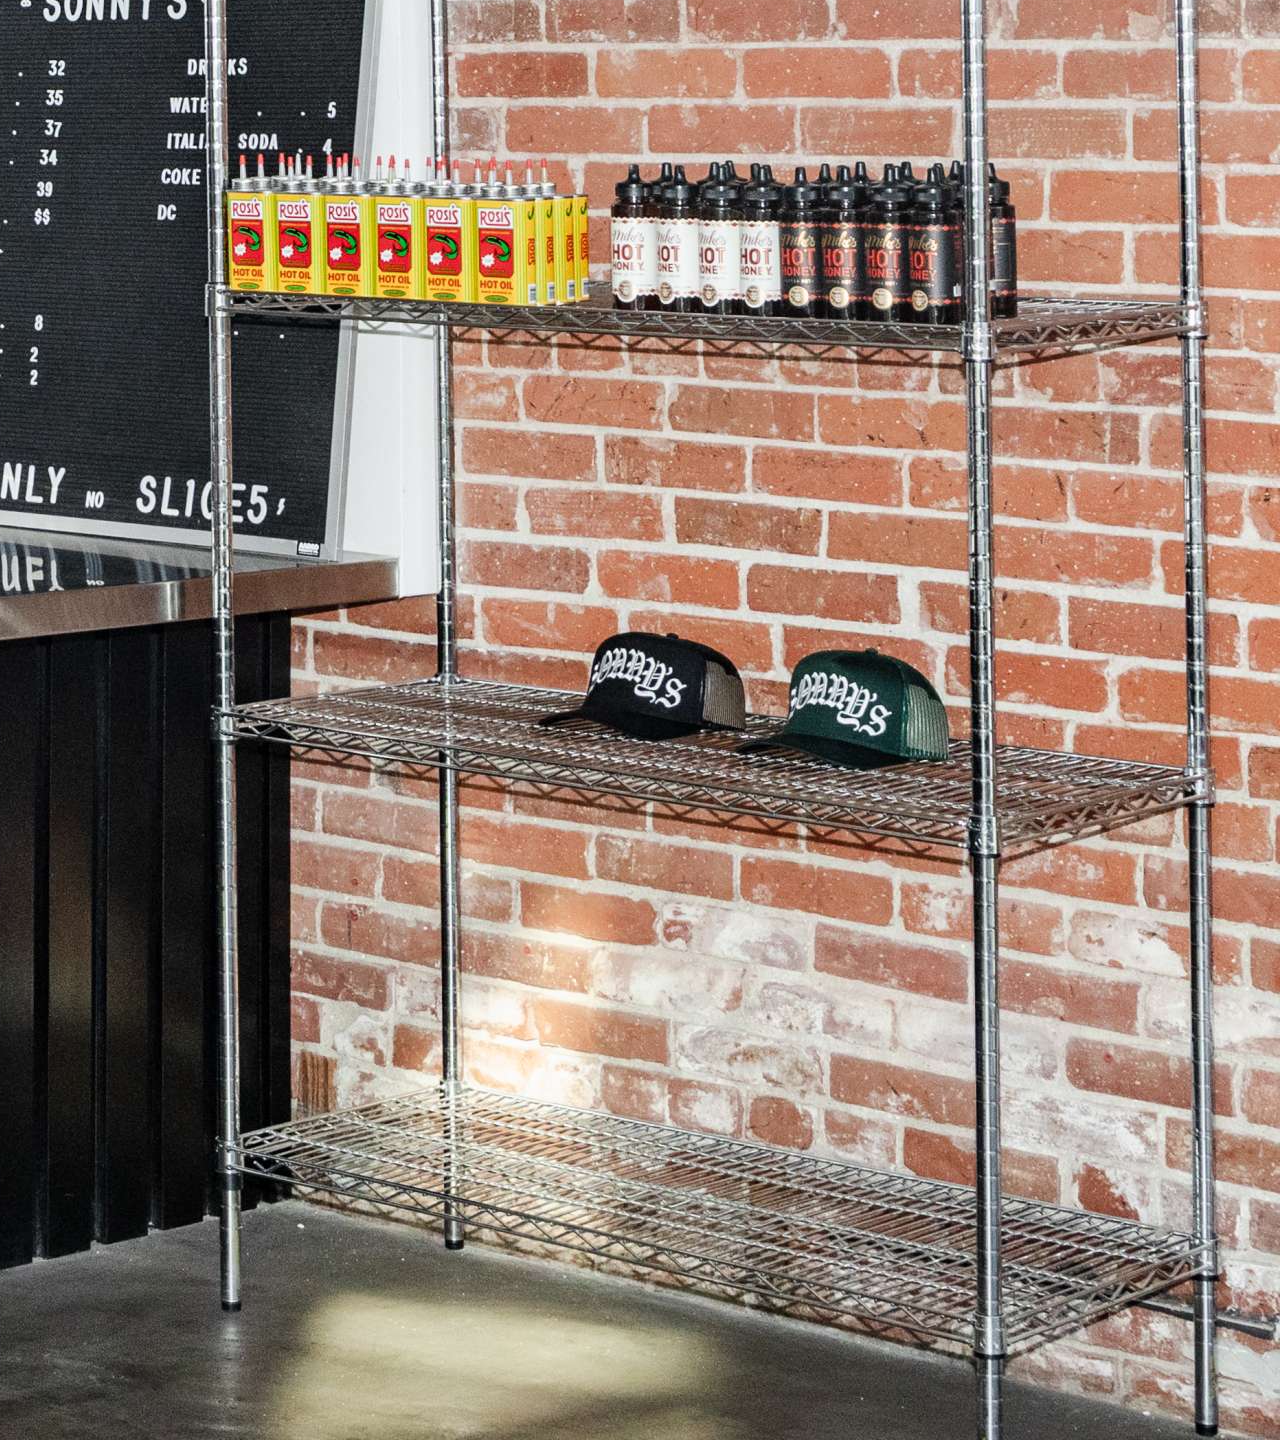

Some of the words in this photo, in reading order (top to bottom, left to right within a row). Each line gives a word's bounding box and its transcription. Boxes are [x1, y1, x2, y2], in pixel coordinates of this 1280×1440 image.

[48, 59, 66, 77] 32
[187, 58, 248, 76] DRKS
[45, 89, 64, 106] 35
[170, 97, 209, 113] WATE
[327, 101, 337, 118] 5
[44, 119, 63, 138] 37
[167, 133, 209, 149] ITALI
[238, 133, 278, 150] SODA
[39, 148, 58, 166] 34
[161, 168, 201, 185] COKE
[36, 181, 54, 198] 39
[33, 207, 51, 226] $$
[157, 204, 177, 221] DC
[741, 248, 772, 265] HOT
[658, 263, 680, 272] ONEY
[328, 273, 346, 281] HOT
[379, 275, 396, 283] HOT
[398, 276, 411, 284] OIL
[428, 278, 446, 286] HOT
[448, 278, 461, 287] OIL
[480, 280, 498, 288] HOT
[500, 281, 513, 289] OIL
[34, 314, 44, 331] 8
[30, 346, 38, 363] 2
[30, 369, 38, 385] 2
[85, 491, 104, 508] NO
